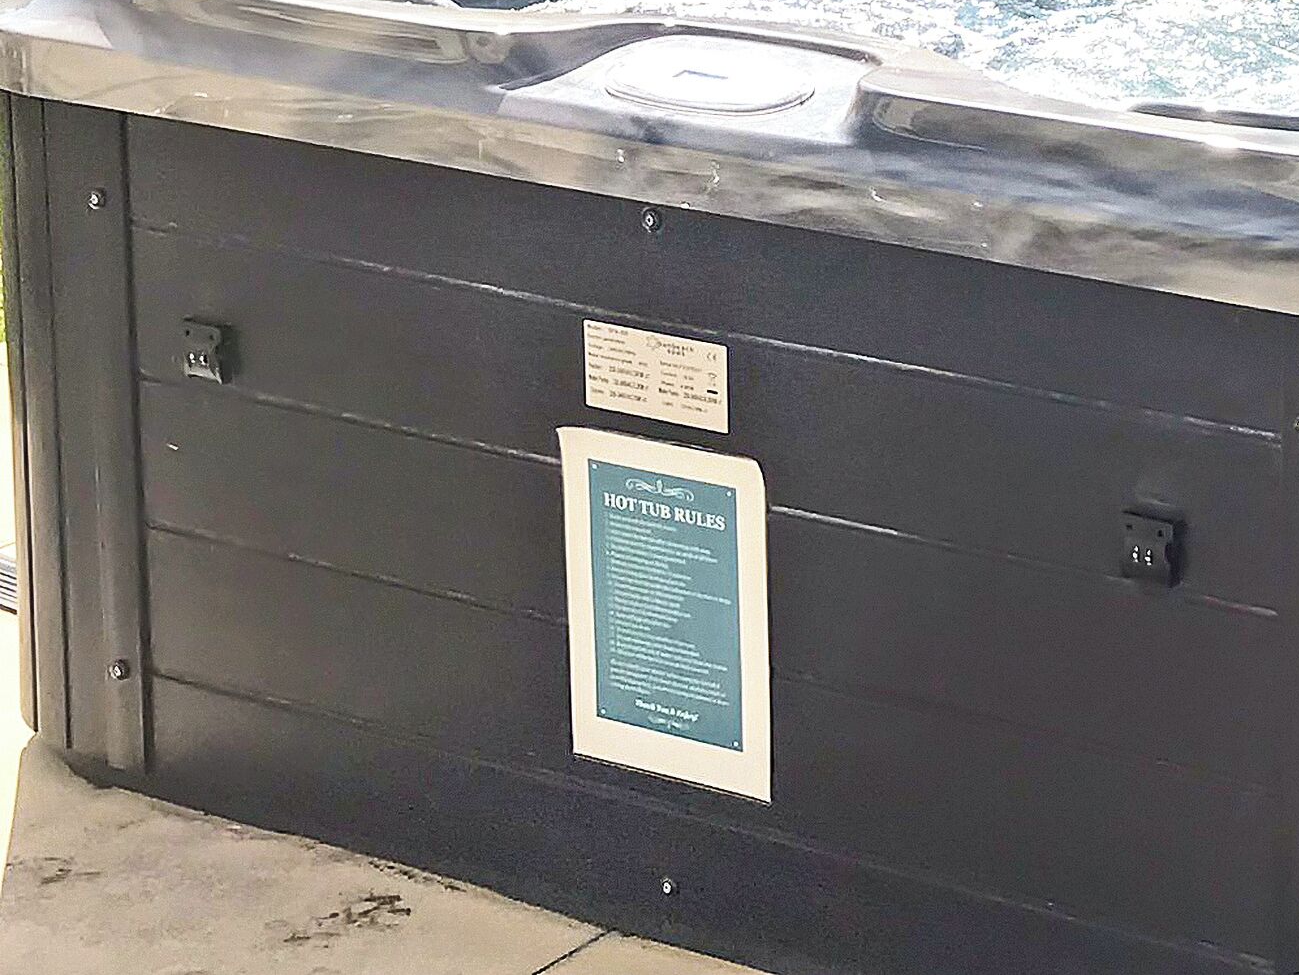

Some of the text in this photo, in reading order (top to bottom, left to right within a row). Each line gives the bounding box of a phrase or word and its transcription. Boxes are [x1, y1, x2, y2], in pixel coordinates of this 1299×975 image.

[603, 492, 638, 512] HOT
[638, 500, 672, 520] TUB
[674, 507, 726, 532] RULES
